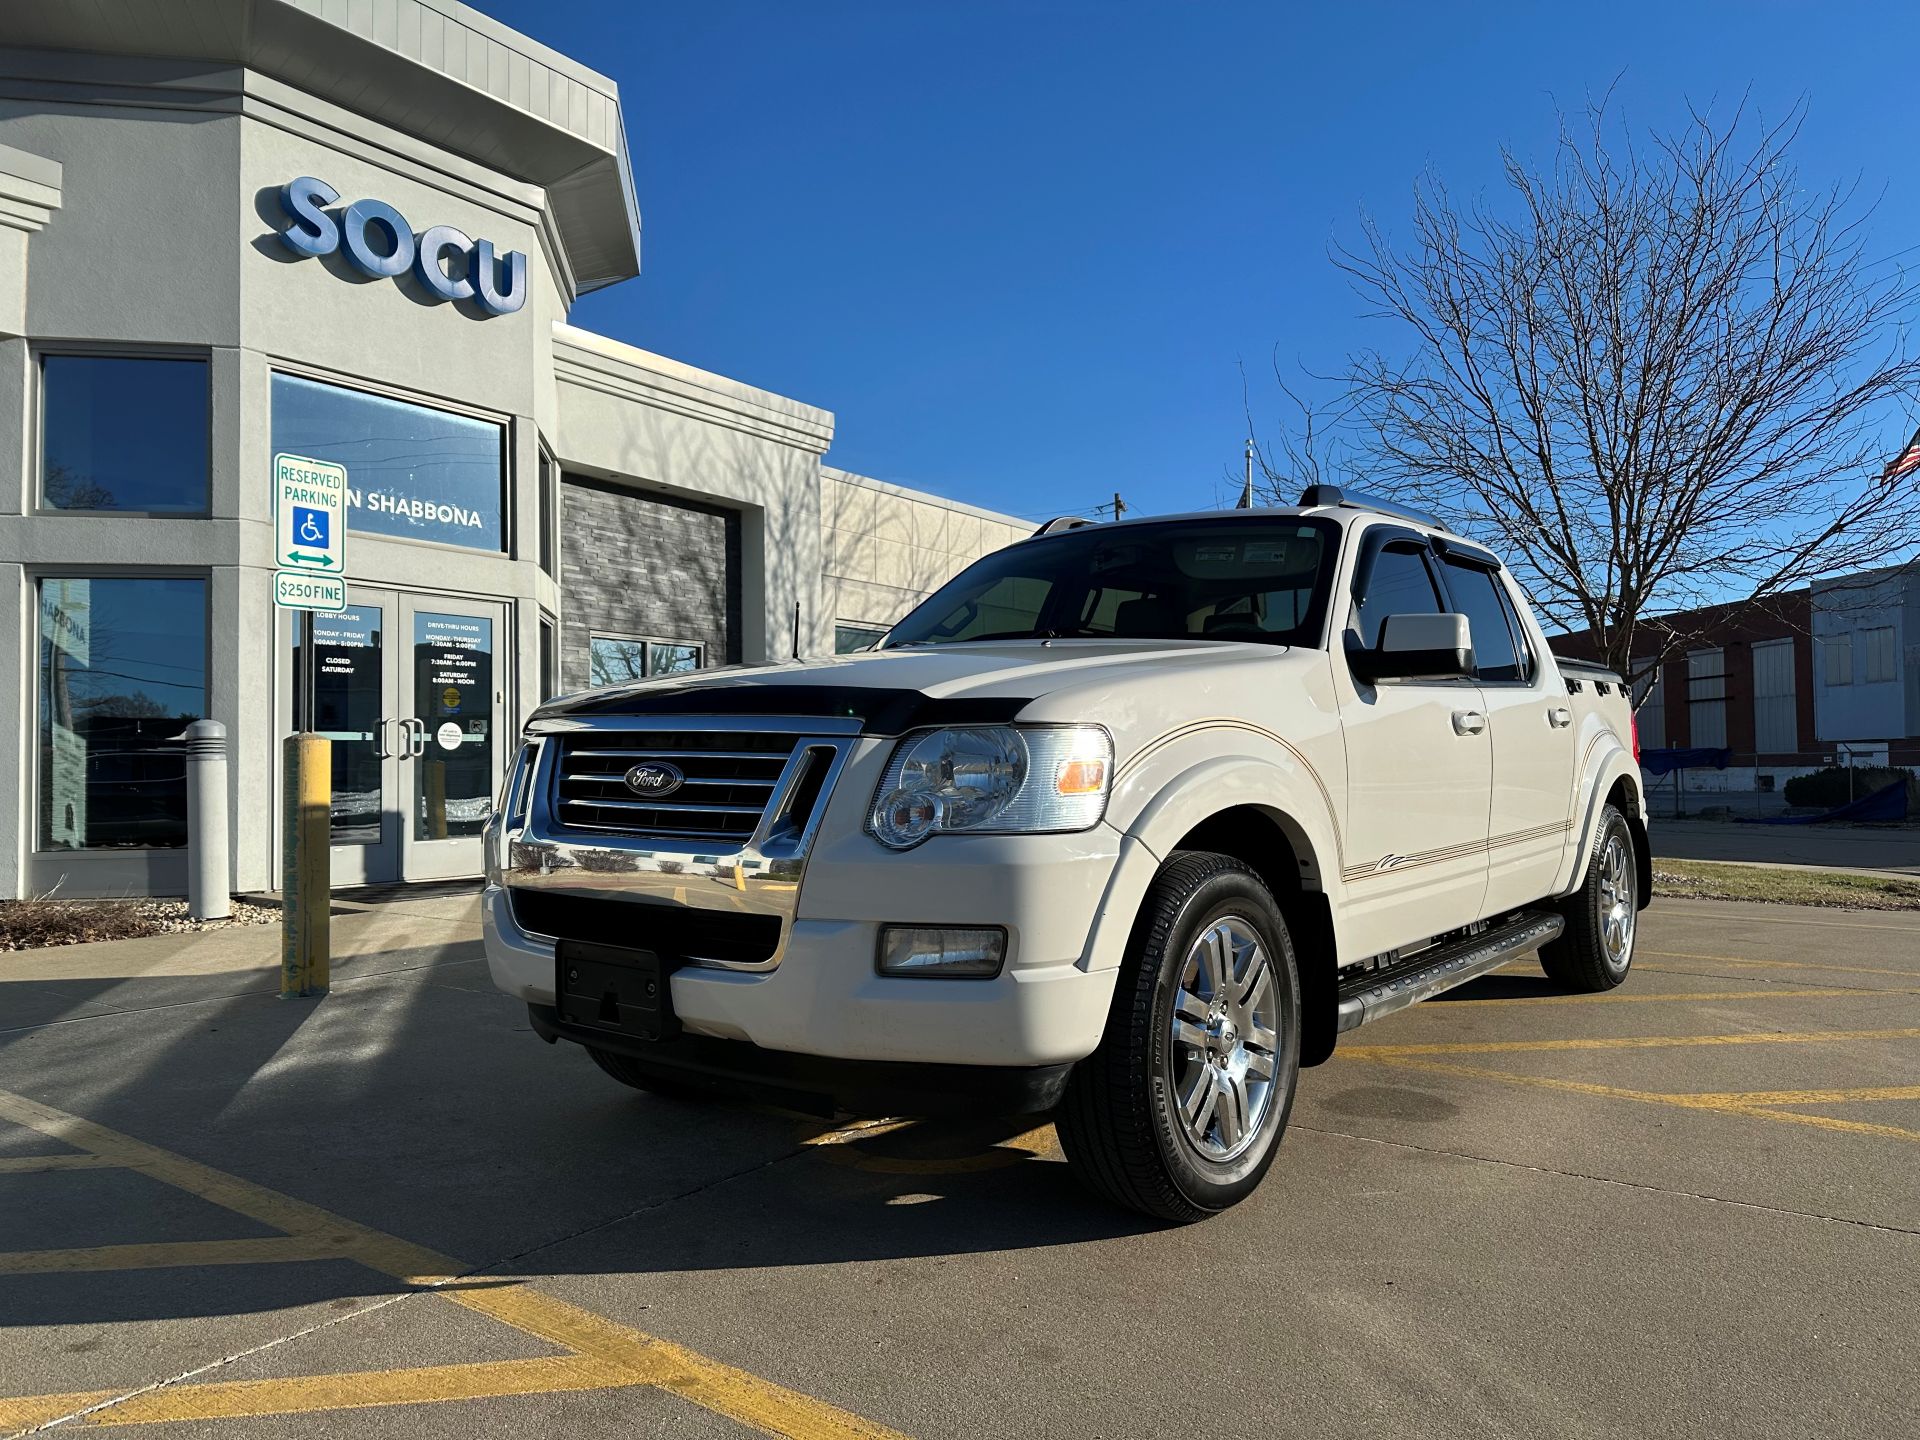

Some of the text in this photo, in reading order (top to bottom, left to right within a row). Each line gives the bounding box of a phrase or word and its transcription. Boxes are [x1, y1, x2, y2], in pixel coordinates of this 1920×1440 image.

[280, 176, 527, 315] SOCU
[280, 466, 341, 489] RESERVED
[284, 486, 337, 508] PARKING
[367, 492, 483, 529] SHABBONA
[279, 580, 341, 600] $250 FINE
[321, 666, 355, 674] SATURDAY
[325, 657, 351, 665] CLOSED
[632, 767, 665, 787] Ford
[1155, 1000, 1165, 1065] DEFENDER
[1155, 1081, 1182, 1167] MICHELIN
